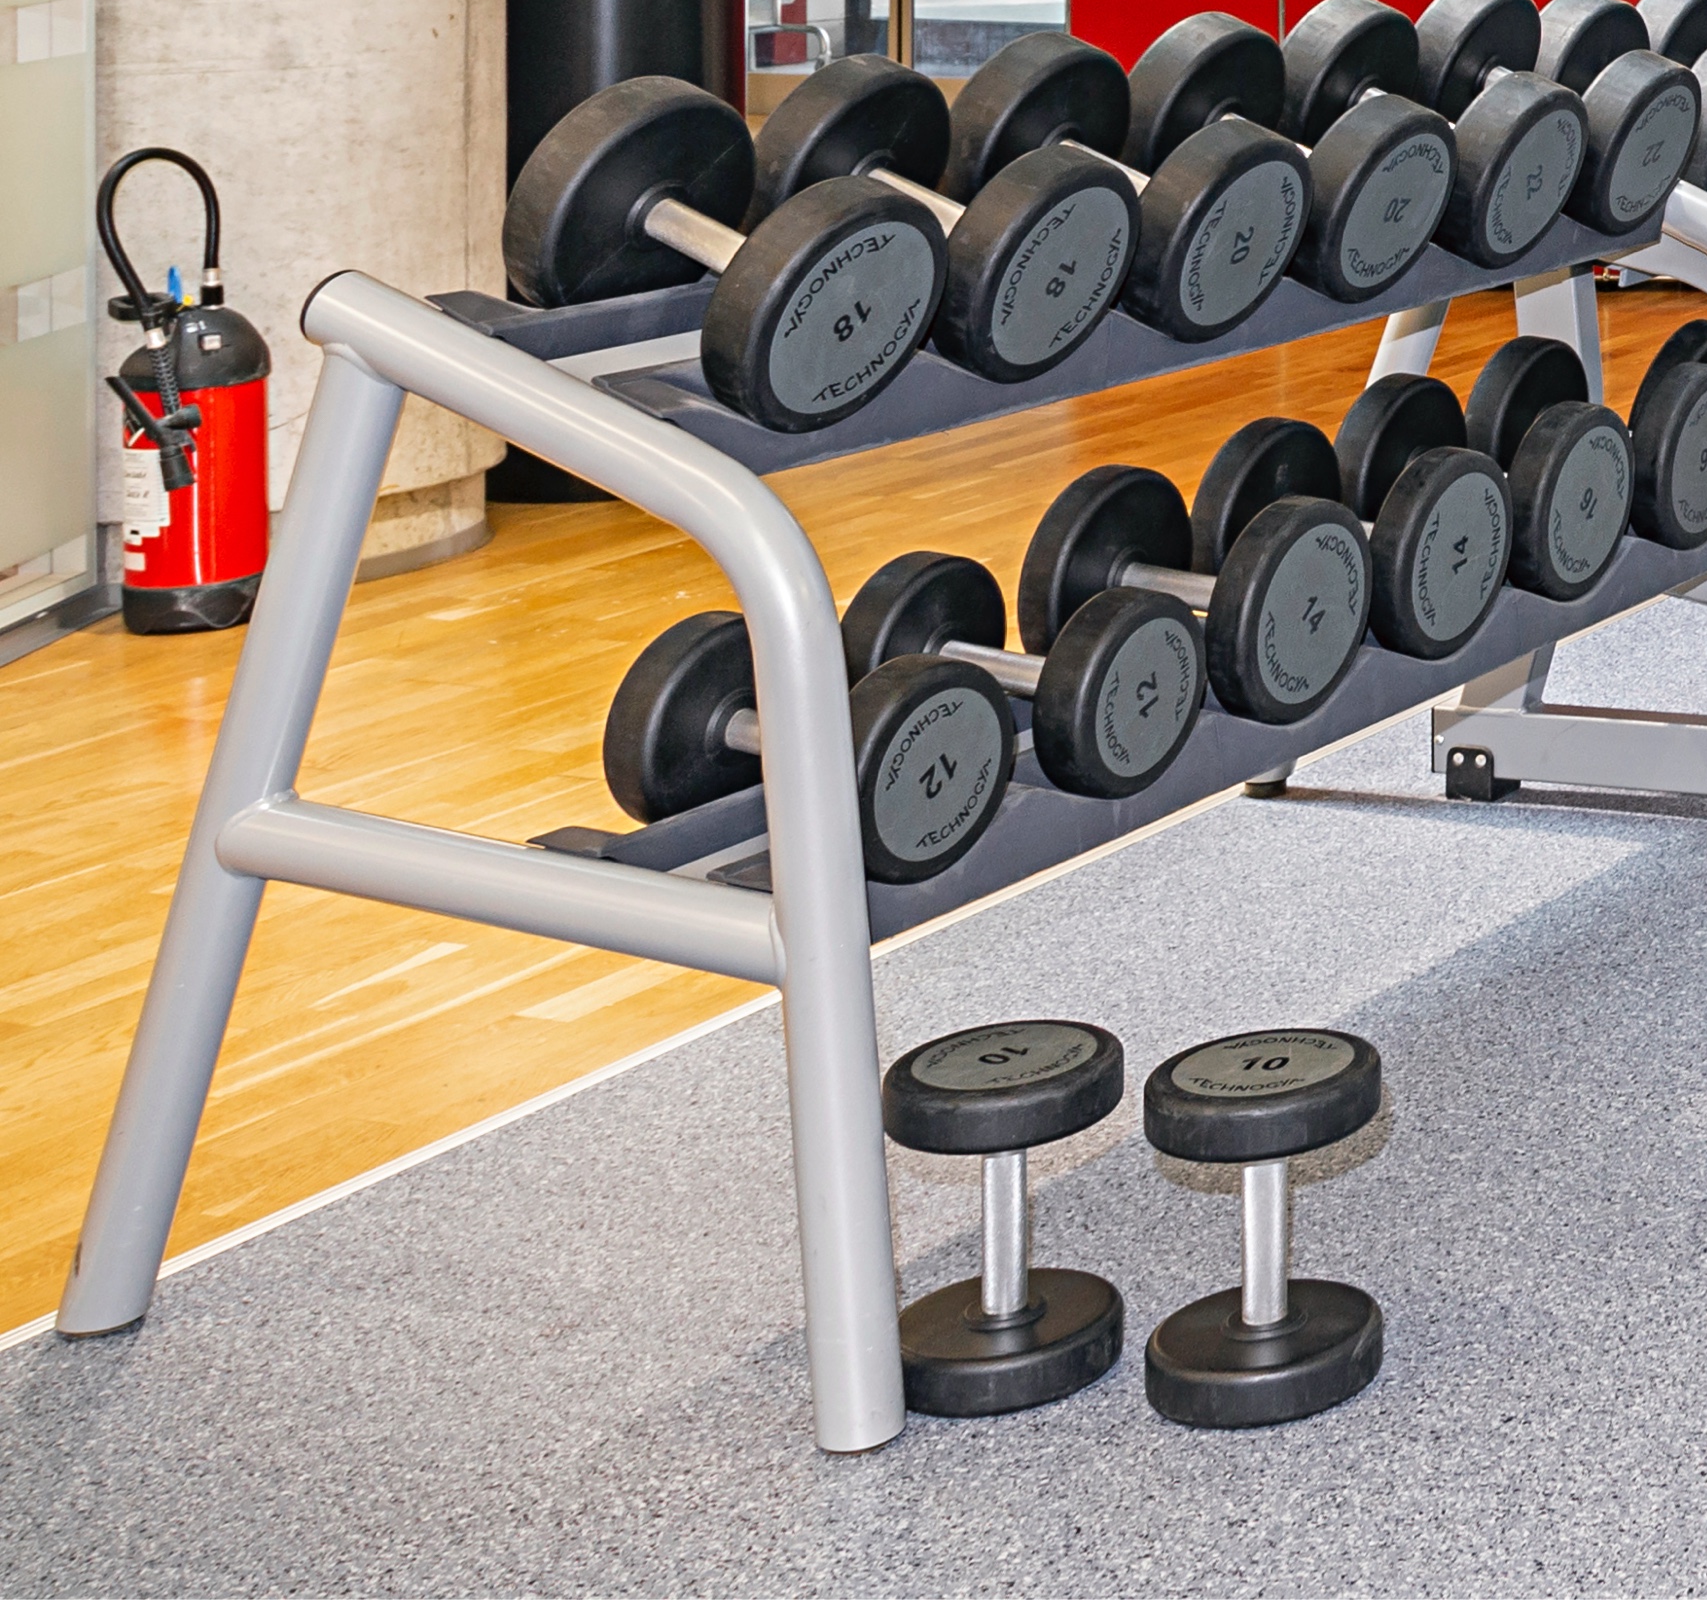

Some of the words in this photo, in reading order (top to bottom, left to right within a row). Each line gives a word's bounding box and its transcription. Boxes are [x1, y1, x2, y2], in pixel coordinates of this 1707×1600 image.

[1382, 143, 1444, 174] TECHNOGYM
[1641, 140, 1665, 168] 22
[1258, 177, 1297, 286] TECHNOGYM
[1383, 197, 1411, 223] 20
[1001, 204, 1077, 325] TECHNOGYM
[1188, 200, 1227, 312] TECHNOGYM
[1230, 226, 1254, 265] 20
[1348, 247, 1410, 278] TECHNOGYM
[784, 234, 896, 338] TECHNOGYM
[1045, 260, 1077, 298] 18
[1049, 228, 1122, 348] TECHNOGYM
[833, 301, 872, 342] 18
[811, 298, 921, 402] TECHNOGYM
[1589, 436, 1625, 500] TECHNOGYM
[1580, 487, 1597, 520] 16
[1452, 535, 1468, 575] 14
[1480, 488, 1501, 600] TECHNOGYM
[1315, 534, 1359, 616] TECHNOGYM
[1418, 512, 1439, 626] TECHNOGYM
[1302, 596, 1326, 635] 14
[1264, 611, 1310, 692] TECHNOGYM
[1136, 671, 1158, 718] 12
[1165, 630, 1191, 721] TECHNOGYM
[1104, 671, 1130, 765] TECHNOGYM
[886, 701, 963, 791] TECHNOGYM
[919, 753, 957, 799] 12
[916, 758, 992, 848] TECHNOGYM
[978, 1047, 1029, 1065] 10
[1223, 1037, 1338, 1050] TECHNOGYM
[1242, 1056, 1290, 1071] 10
[1189, 1077, 1306, 1092] TECHNOGYM
